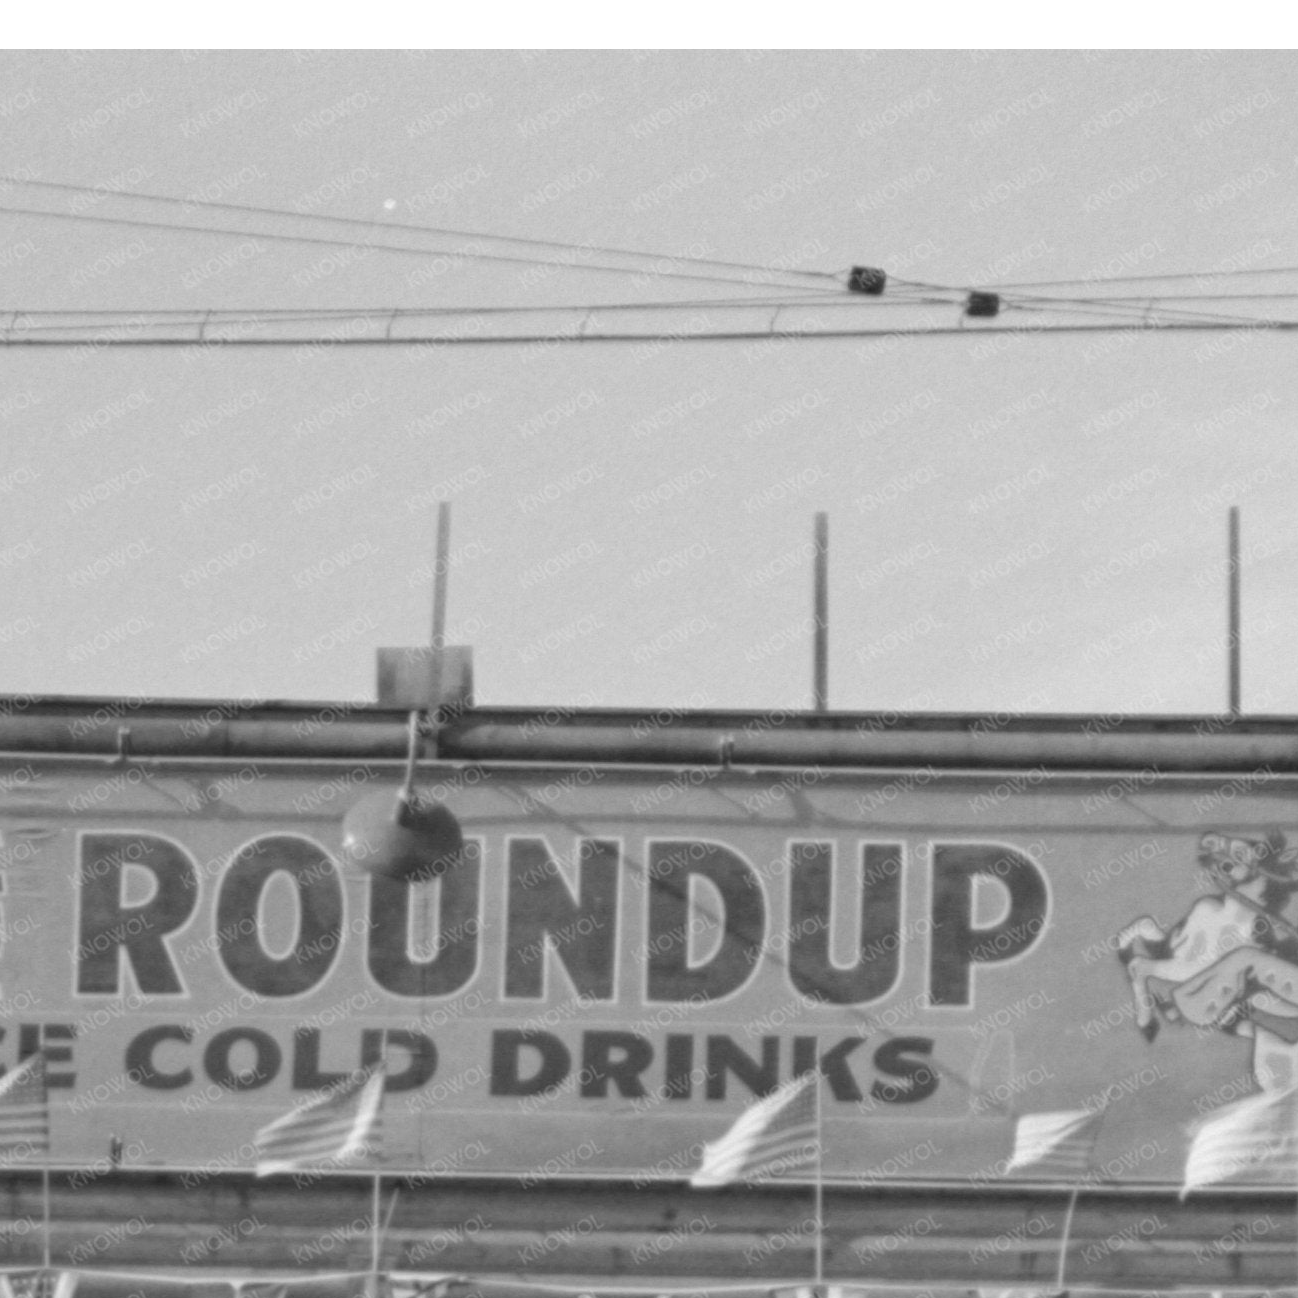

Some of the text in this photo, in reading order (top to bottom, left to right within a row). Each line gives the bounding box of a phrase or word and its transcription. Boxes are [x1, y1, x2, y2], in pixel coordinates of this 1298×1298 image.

[75, 830, 1051, 1007] ROUNDUP
[124, 1025, 438, 1094] COLD
[489, 1029, 941, 1103] DRINKS
